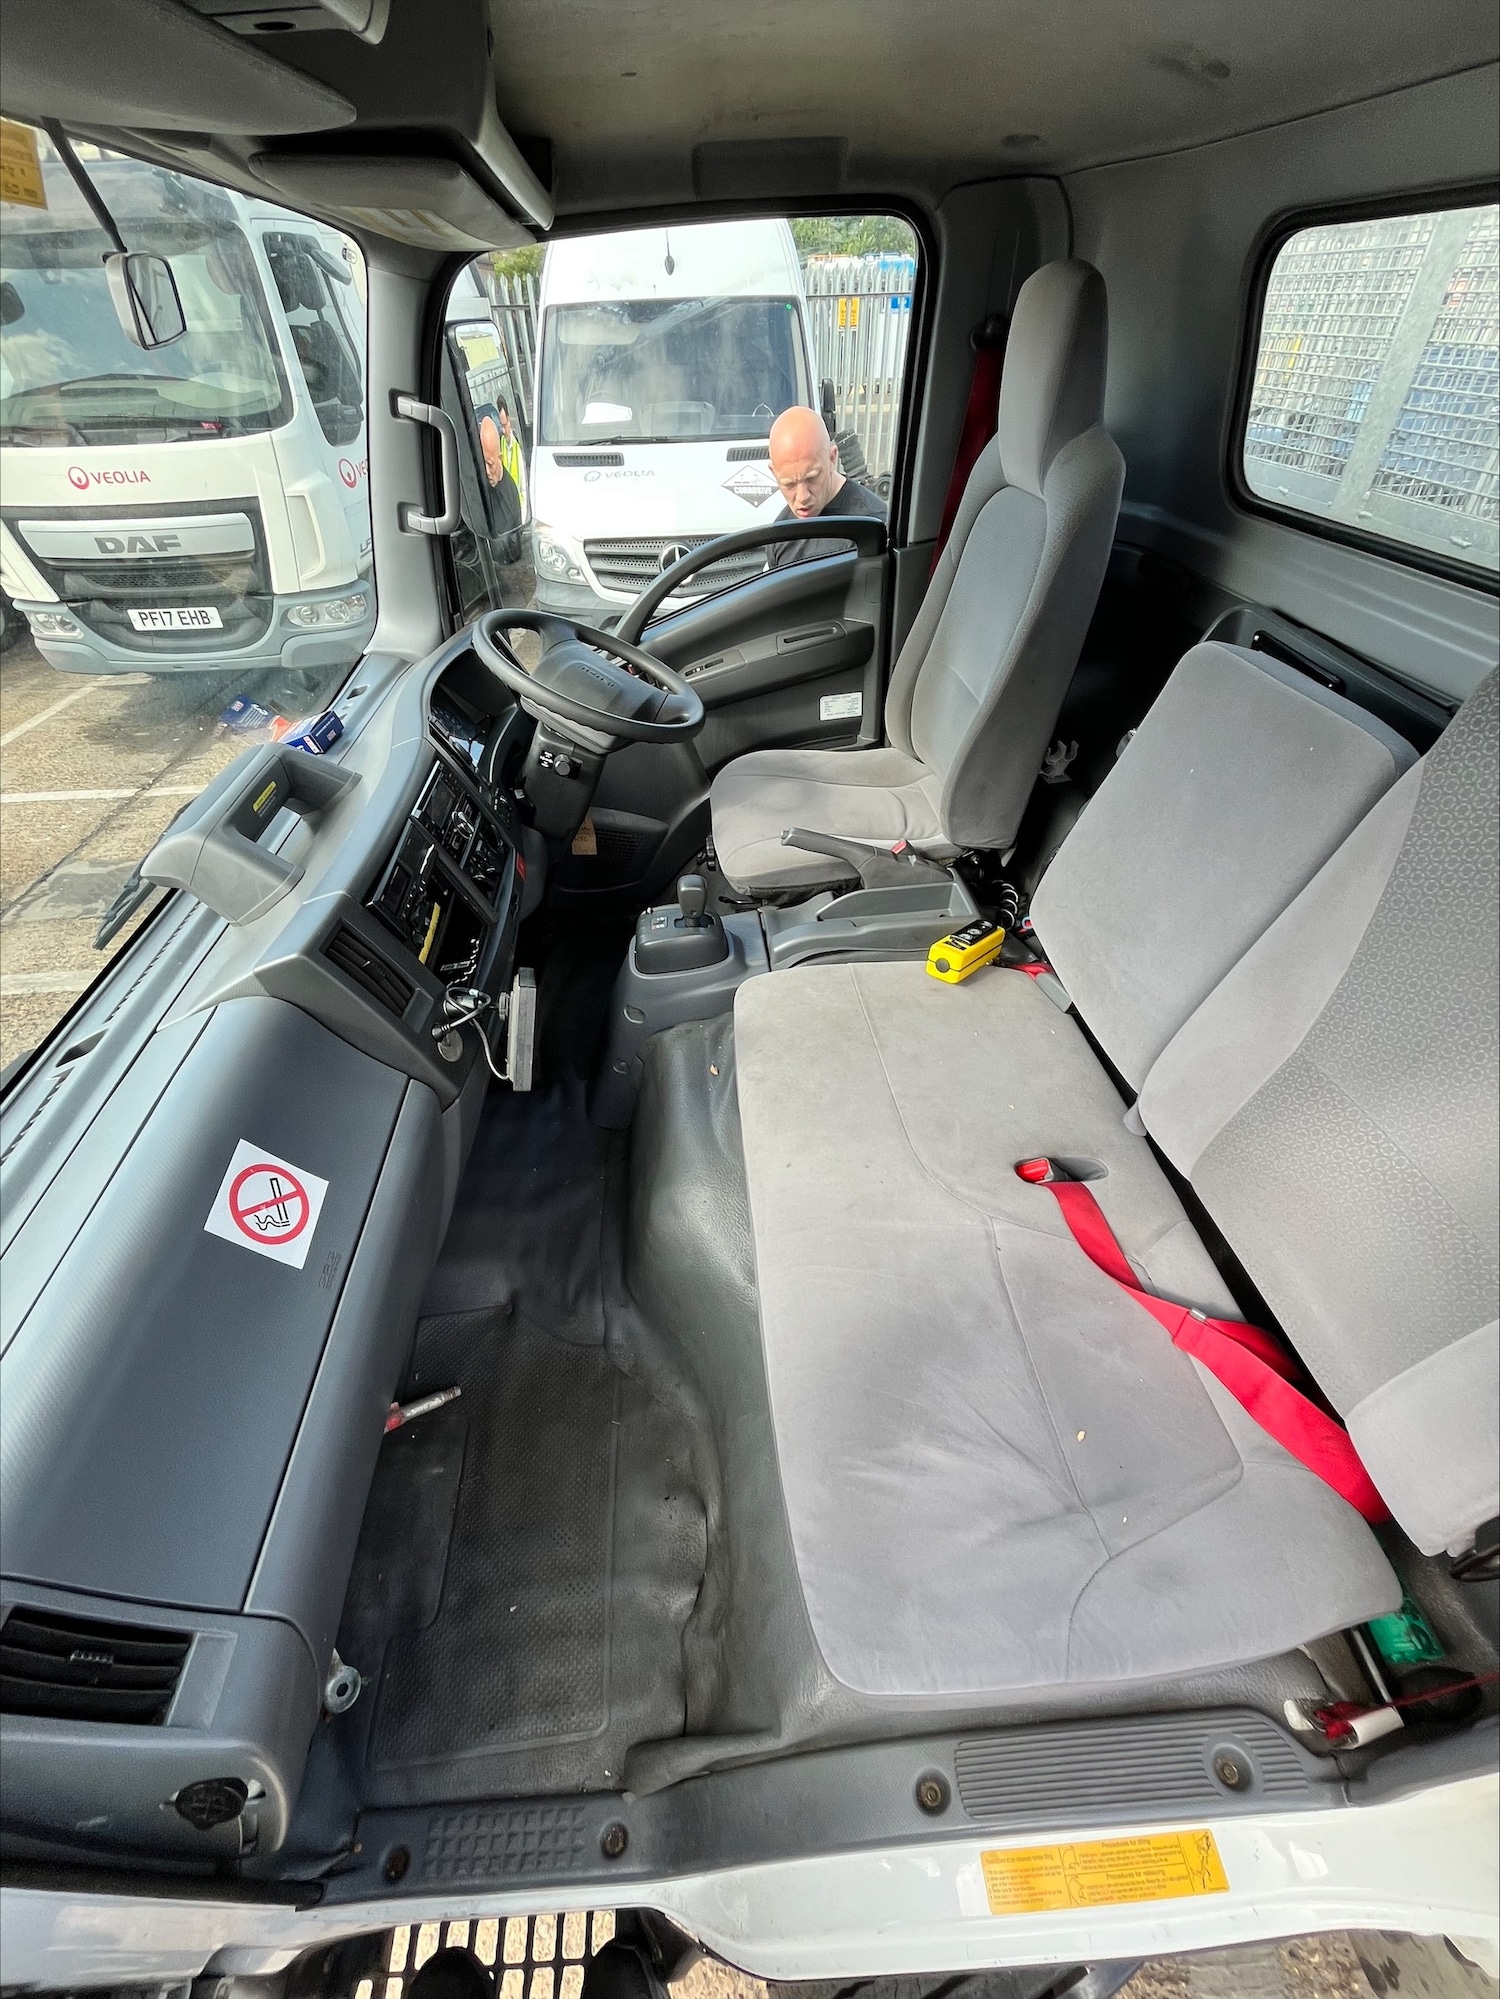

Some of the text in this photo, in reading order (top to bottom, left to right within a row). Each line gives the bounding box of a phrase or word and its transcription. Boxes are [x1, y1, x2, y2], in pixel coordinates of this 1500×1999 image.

[90, 470, 151, 484] VEOLIA
[605, 470, 655, 478] VEOLIA
[733, 486, 773, 496] CORROSIVE
[94, 534, 182, 554] DAF
[138, 610, 211, 626] PF17 EHB
